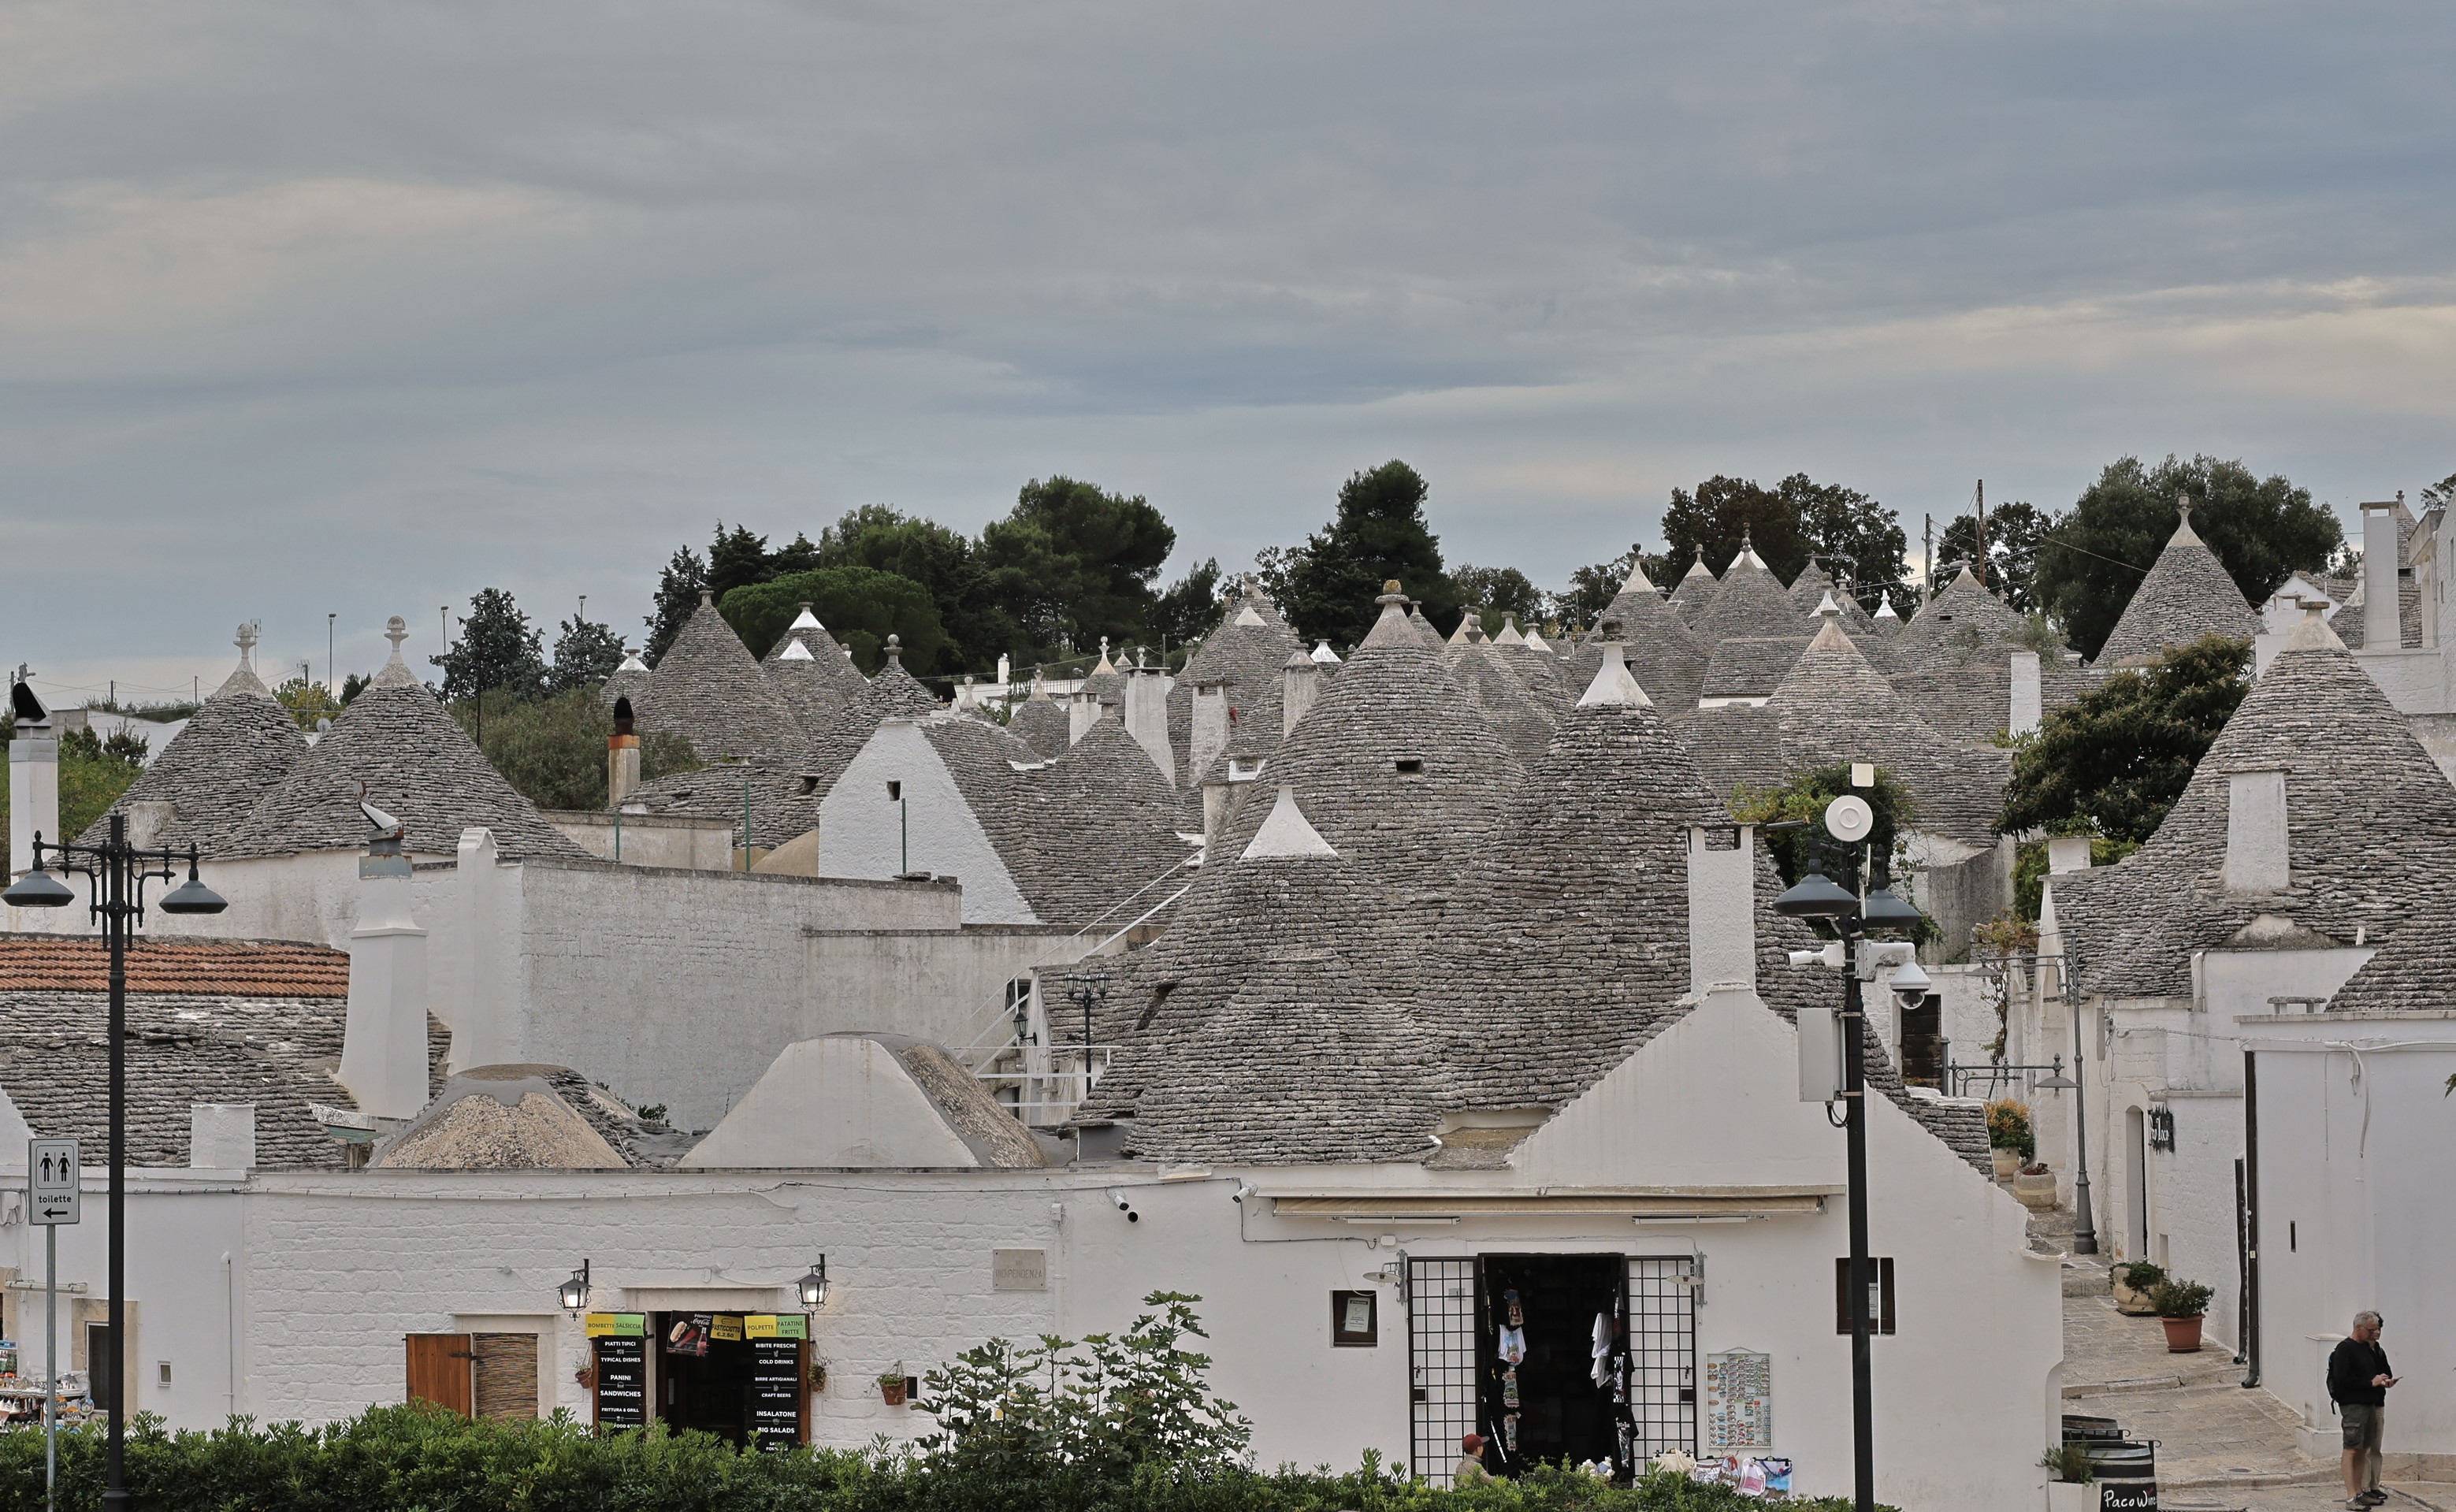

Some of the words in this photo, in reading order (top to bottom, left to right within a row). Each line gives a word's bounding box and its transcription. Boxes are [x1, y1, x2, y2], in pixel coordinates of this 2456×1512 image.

[38, 1194, 72, 1203] toilette
[995, 1269, 1043, 1279] INDPENDENZA
[2103, 1489, 2135, 1508] Paco
